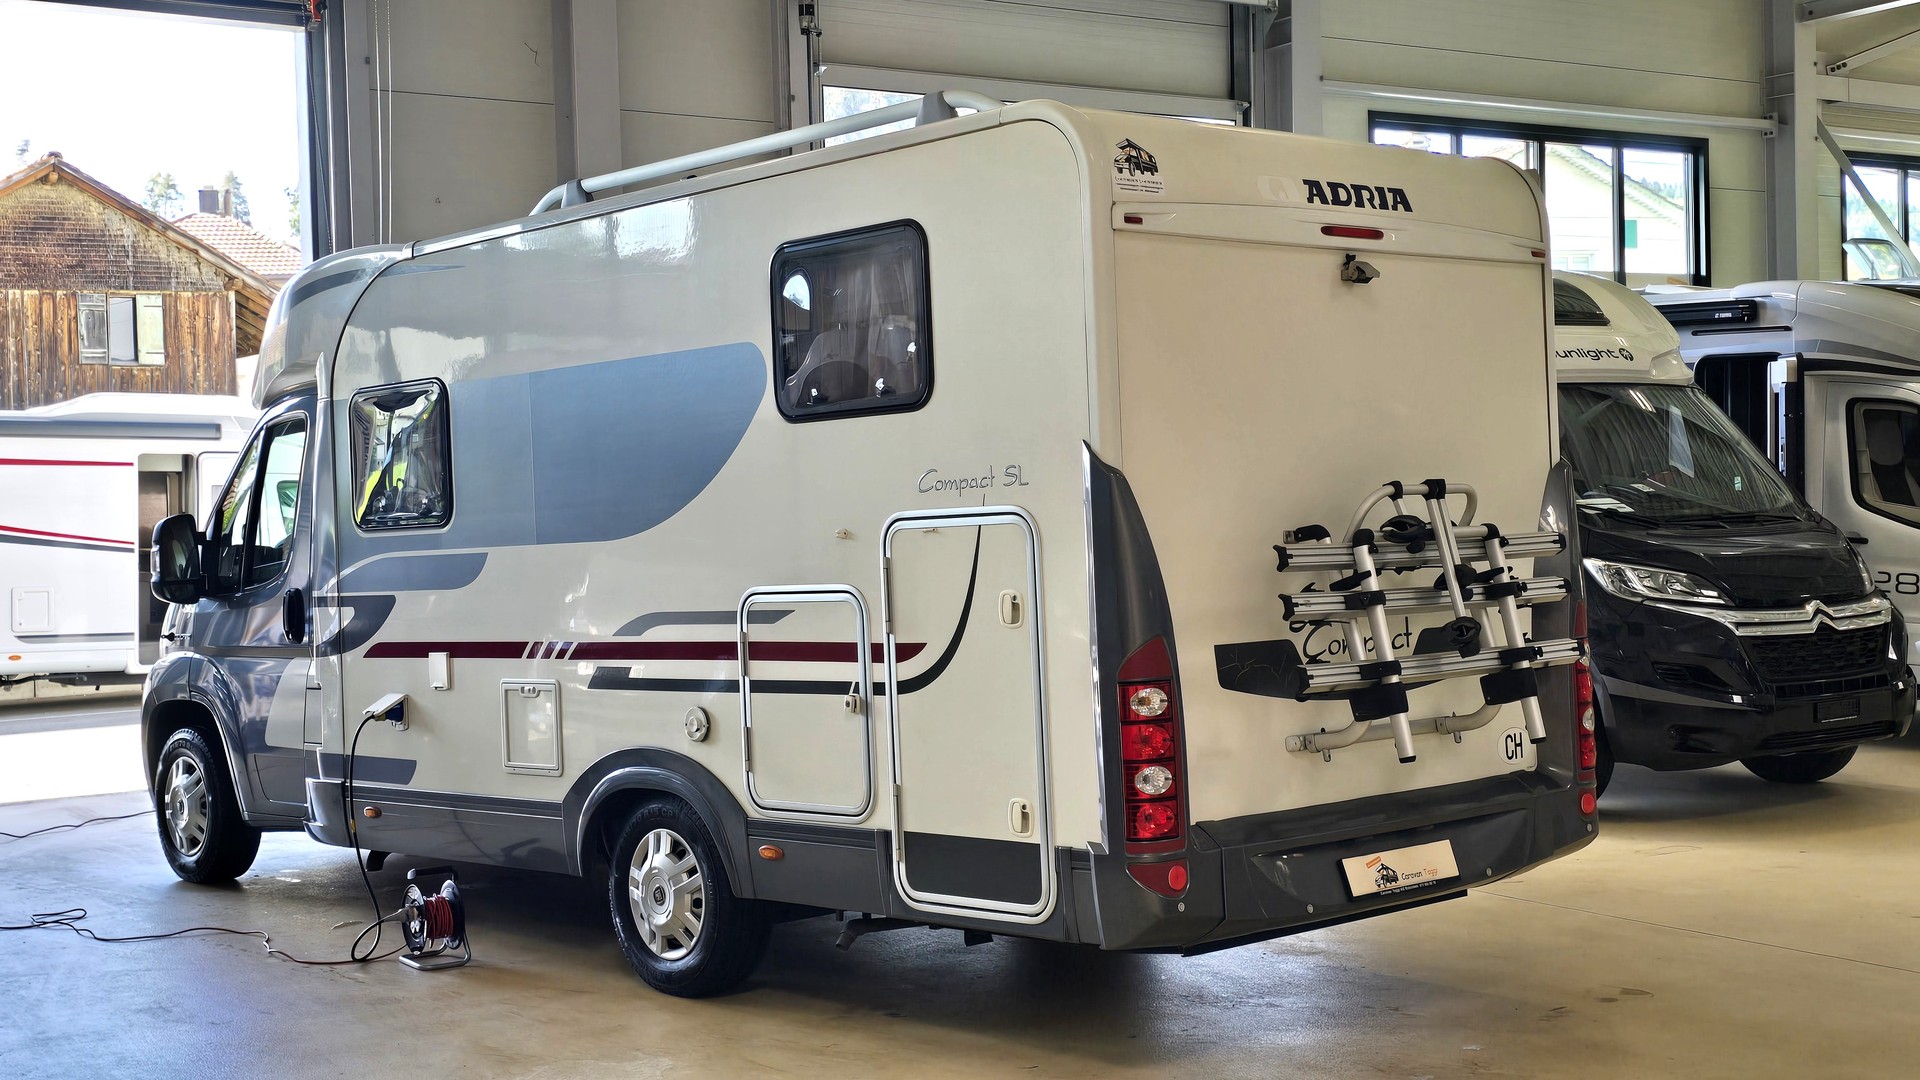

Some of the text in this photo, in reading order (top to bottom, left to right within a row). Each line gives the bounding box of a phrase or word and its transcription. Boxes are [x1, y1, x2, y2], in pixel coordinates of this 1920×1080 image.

[1302, 179, 1413, 212] ADRIA
[1555, 347, 1619, 361] unlight
[918, 464, 1029, 497] Compact SL
[1505, 732, 1523, 760] CH
